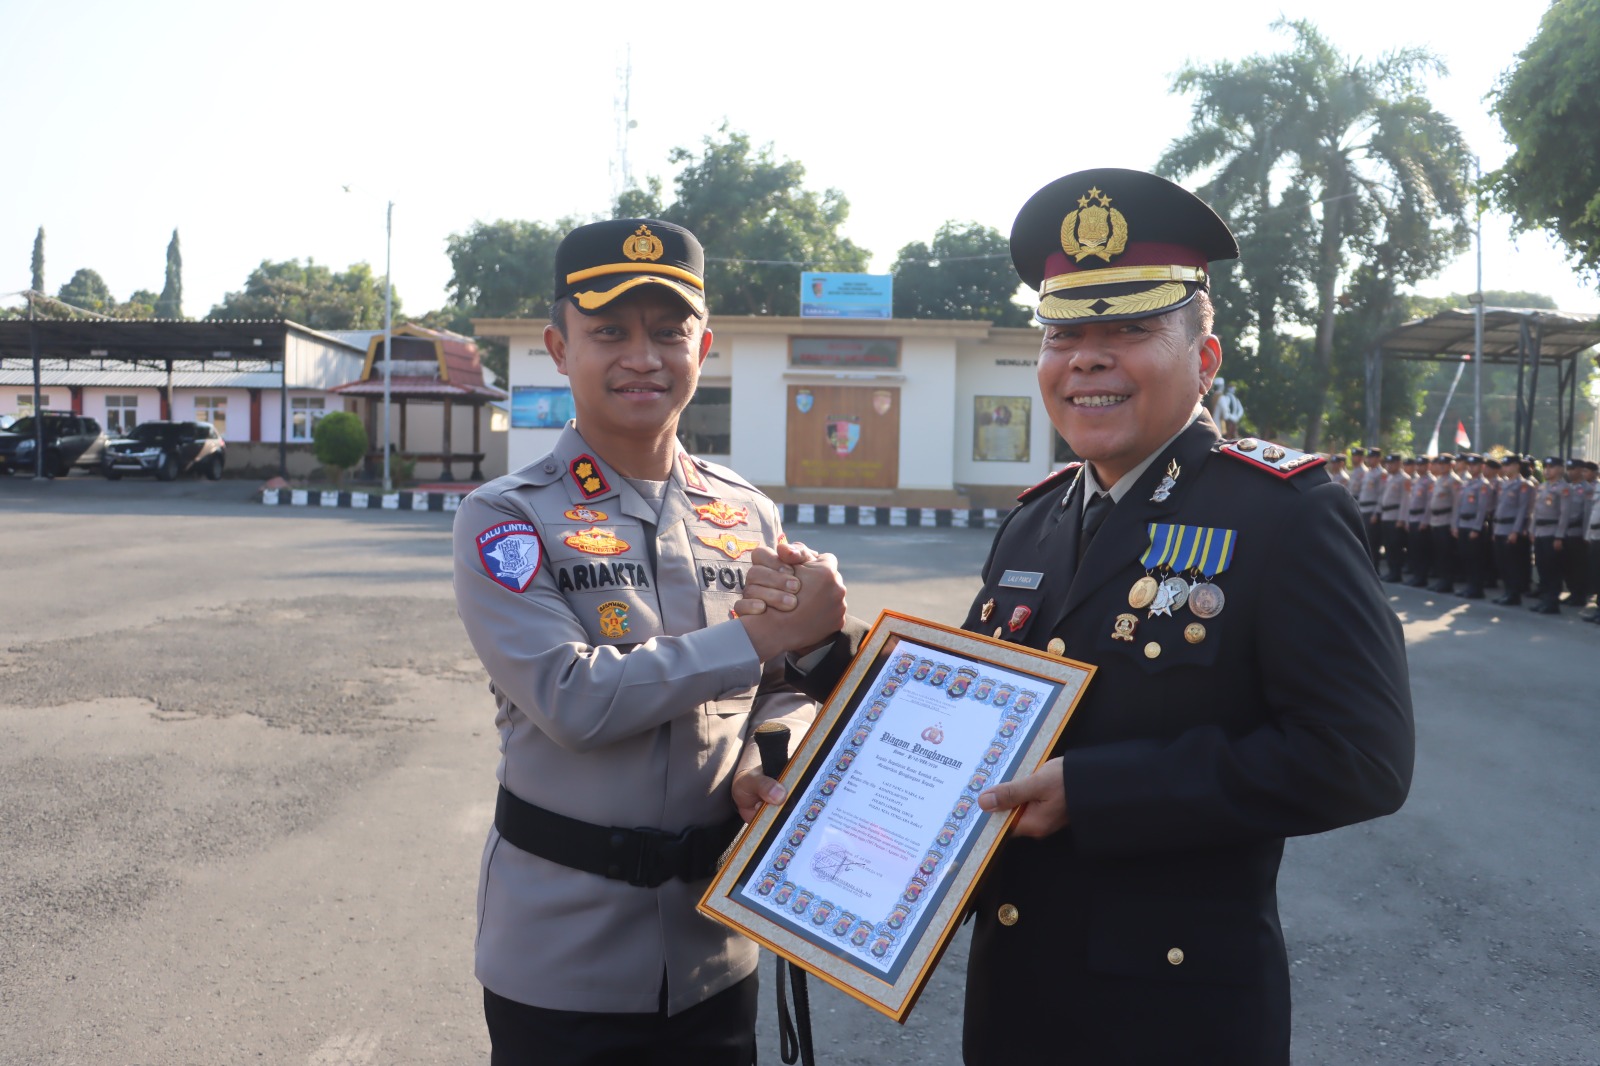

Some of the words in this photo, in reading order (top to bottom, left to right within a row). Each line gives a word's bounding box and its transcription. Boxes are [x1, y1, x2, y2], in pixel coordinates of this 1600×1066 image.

[480, 527, 500, 543] LALU
[503, 524, 534, 532] LINTAS
[559, 562, 650, 593] ARIAKTA
[702, 566, 745, 590] POL
[880, 732, 910, 749] Piagam
[912, 743, 963, 769] Penghargaan
